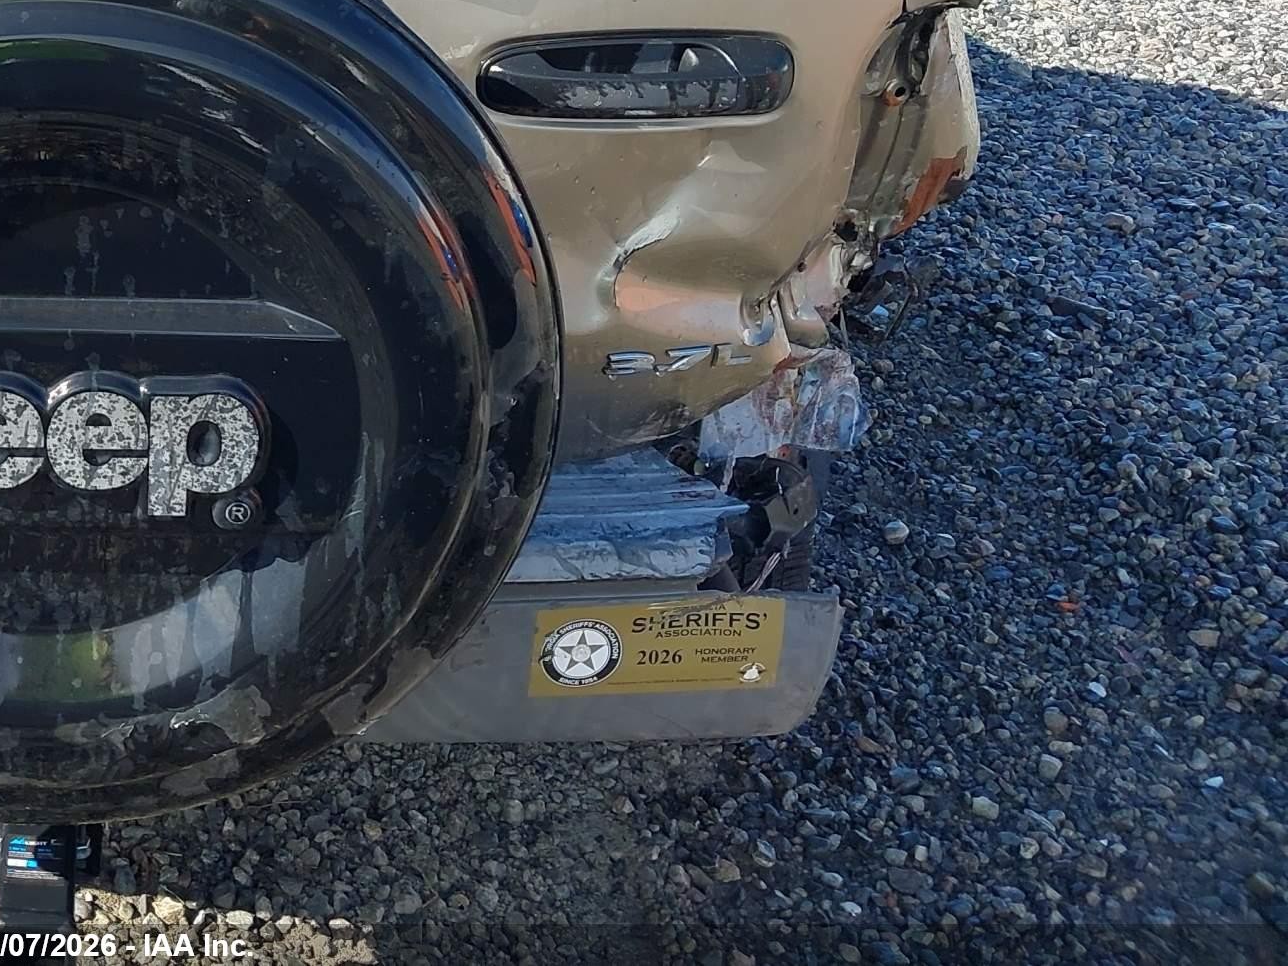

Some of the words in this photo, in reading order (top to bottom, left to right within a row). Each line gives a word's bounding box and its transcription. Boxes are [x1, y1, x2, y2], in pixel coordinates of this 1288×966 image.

[655, 628, 742, 639] ASSOCIATION
[594, 623, 619, 659] ASSOCIATION
[636, 649, 683, 665] 2026
[695, 647, 757, 655] HONORARY
[701, 655, 749, 663] MEMBER
